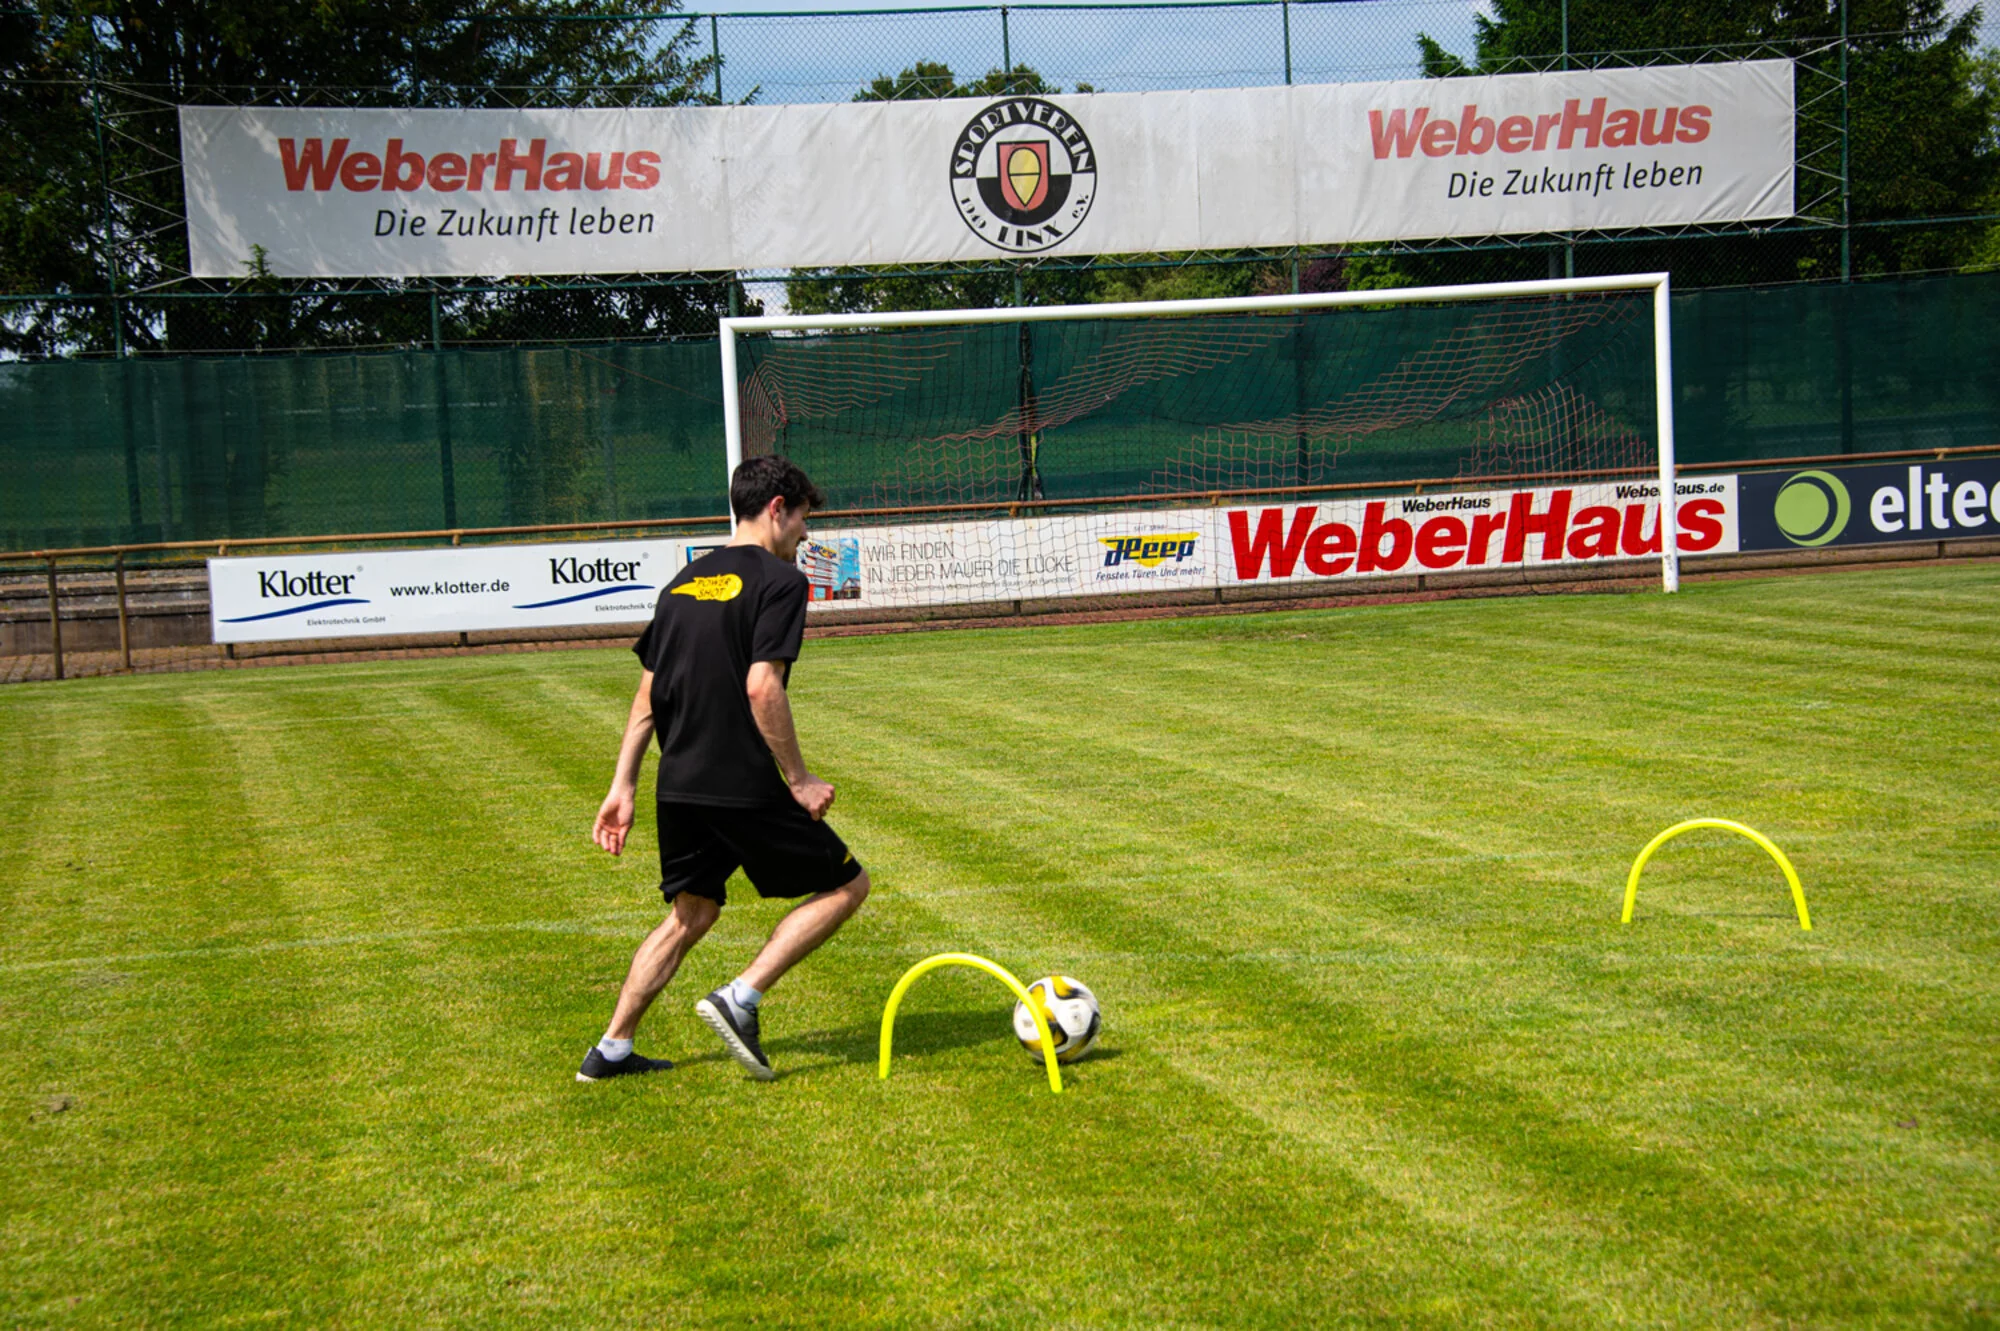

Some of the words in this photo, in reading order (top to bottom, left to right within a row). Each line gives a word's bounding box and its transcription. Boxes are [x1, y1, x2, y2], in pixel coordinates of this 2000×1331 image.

[955, 102, 1093, 176] SPORTVEREIN
[1368, 97, 1712, 160] WeberHaus
[277, 137, 661, 193] WeberHaus
[1448, 171, 1494, 198] Die
[1503, 164, 1615, 197] Zukunft
[1623, 161, 1703, 189] leben
[374, 209, 426, 237] Die
[438, 208, 560, 242] Zukunft
[569, 206, 655, 234] leben
[997, 220, 1063, 248] LINX
[1403, 496, 1491, 513] WeberHaus
[1616, 482, 1725, 499] Webeaus.de
[1227, 489, 1726, 580] WeberHaus
[866, 544, 896, 562] WIR
[901, 541, 954, 561] FINDEN
[549, 557, 641, 584] Klotter
[868, 566, 883, 583] IN
[887, 563, 936, 583] JEDER
[940, 560, 993, 579] MAUER
[998, 558, 1020, 577] DIE
[1026, 553, 1078, 574] LÜCKE.
[257, 570, 355, 598] Klotter
[390, 579, 510, 596] www.klotter.de
[698, 587, 726, 598] SHOT
[307, 618, 360, 626] Elektrotechnik
[362, 616, 386, 624] GmbH
[595, 603, 645, 612] Elektrotechnik
